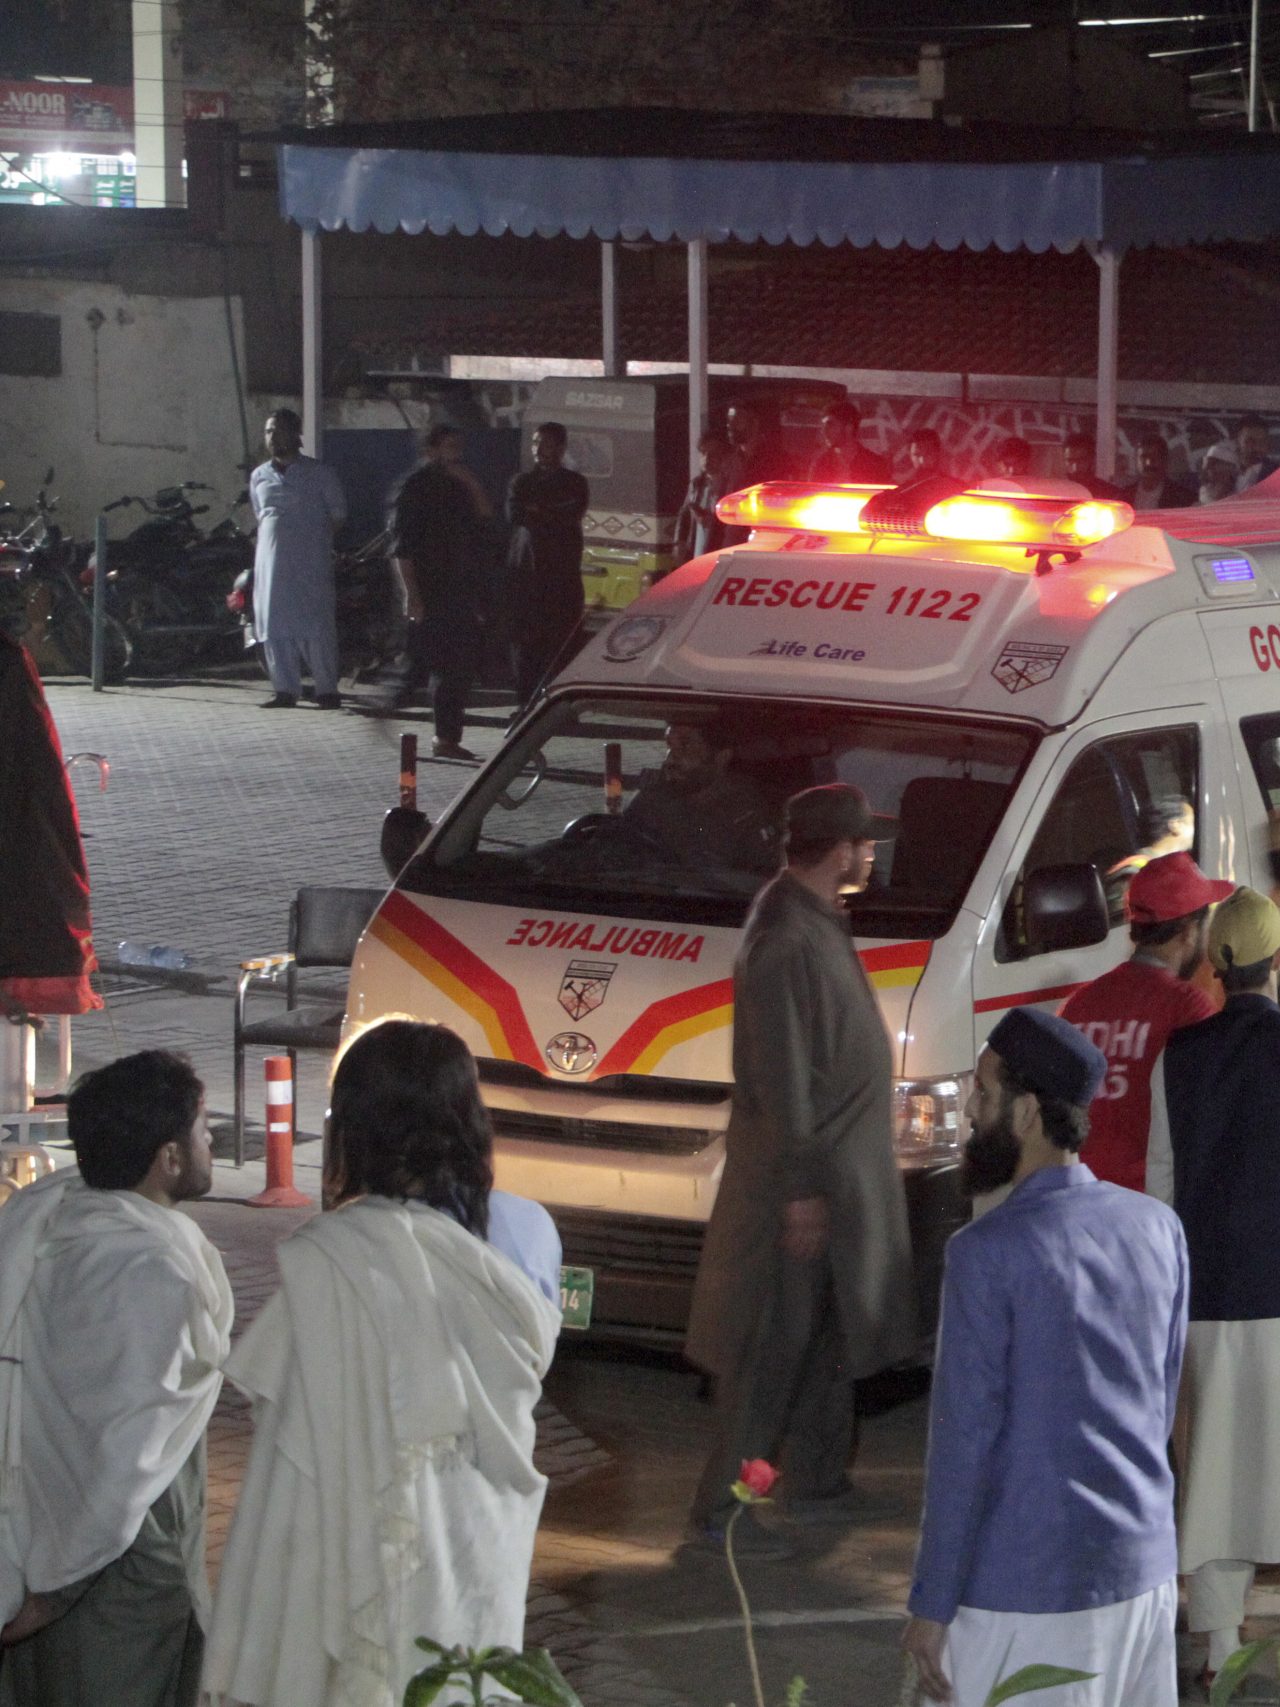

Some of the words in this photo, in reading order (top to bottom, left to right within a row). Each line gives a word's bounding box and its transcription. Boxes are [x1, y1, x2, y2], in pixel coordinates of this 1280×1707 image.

[0, 91, 66, 114] -NOOR
[712, 577, 876, 611] RESCUE
[885, 586, 982, 622] 1122
[766, 640, 807, 657] Life
[813, 643, 866, 661] Care
[1072, 1019, 1151, 1060] DHI
